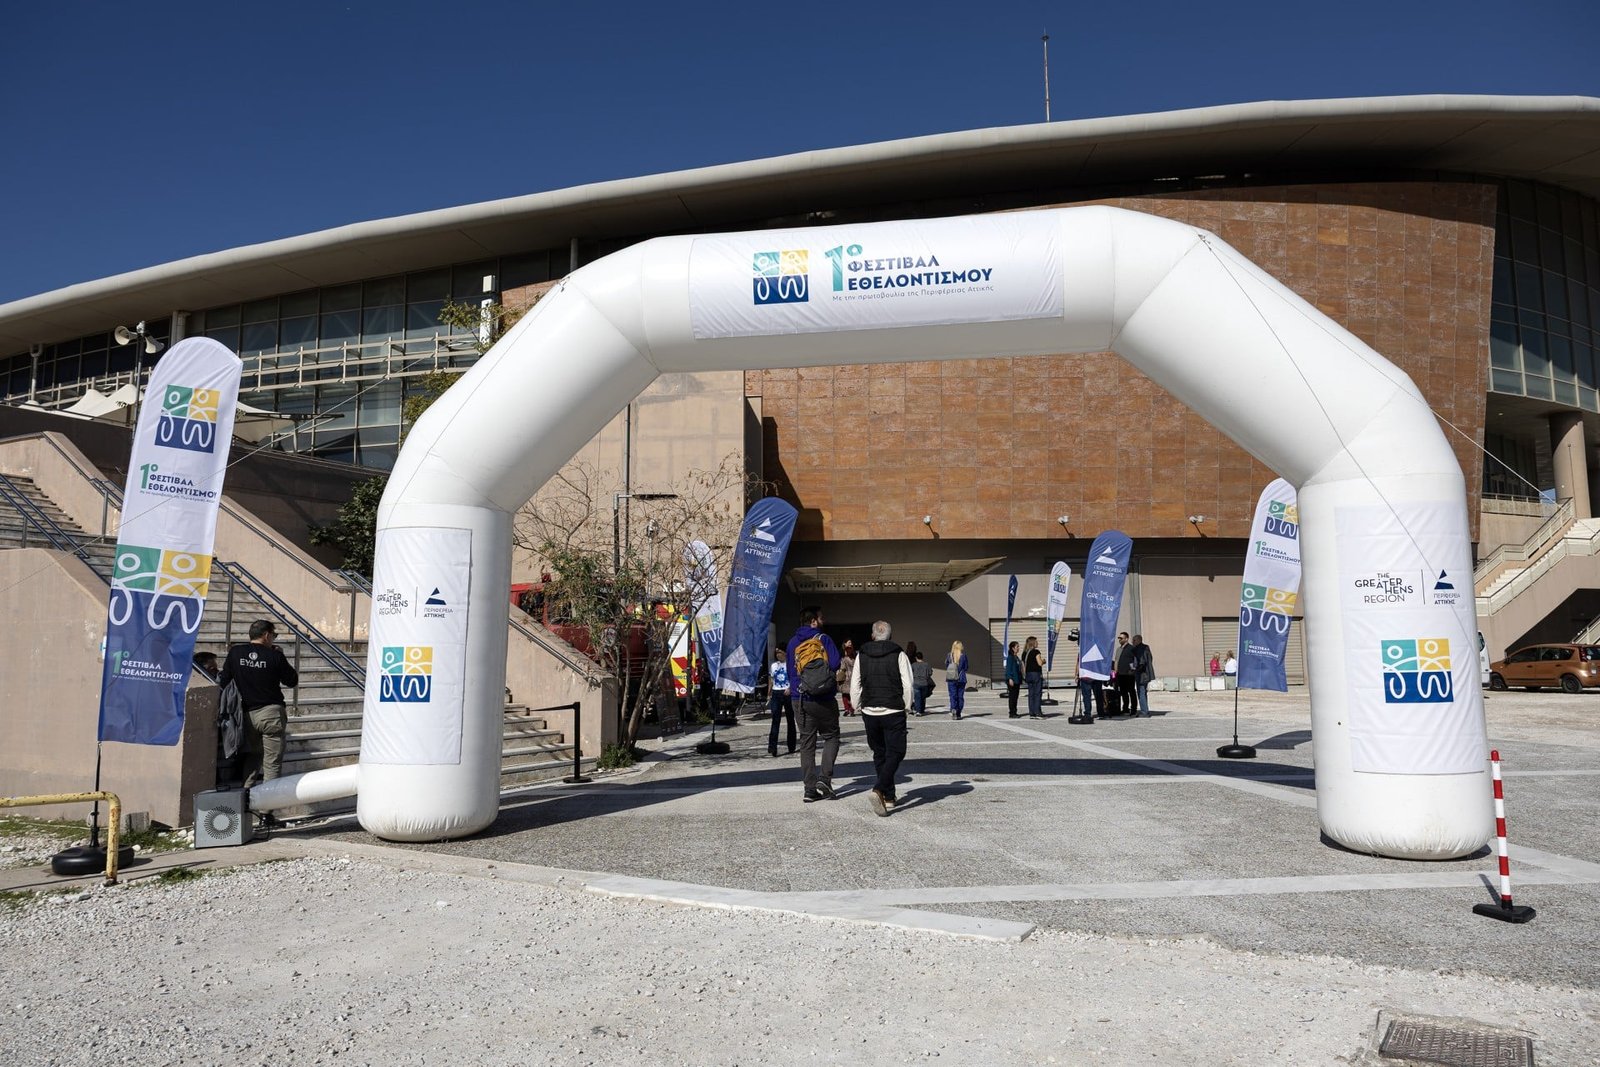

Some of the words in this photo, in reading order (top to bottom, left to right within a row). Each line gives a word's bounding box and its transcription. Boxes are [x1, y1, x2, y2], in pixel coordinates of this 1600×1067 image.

[848, 256, 940, 273] ΦΕΣΤΙΒΑΛ
[848, 268, 993, 291] ΕΘΕΛΟΝΤΙΣΜΟΥ
[149, 474, 194, 487] ΦΕΣΤΙΒΑΛ
[148, 483, 218, 499] ΕΘΕΛΟΝΤΙΣΜΟΥ
[744, 548, 772, 559] ΑΤΤΙΚΗΣ
[1354, 578, 1403, 589] GREATER
[738, 591, 767, 603] REGION
[1364, 594, 1405, 604] REGION
[379, 607, 402, 615] REGION
[121, 660, 161, 670] ΦΕΣΤΙΒΑΛ
[120, 668, 183, 680] ΕΘΕΛΟΝΤΙΣΜΟΥ
